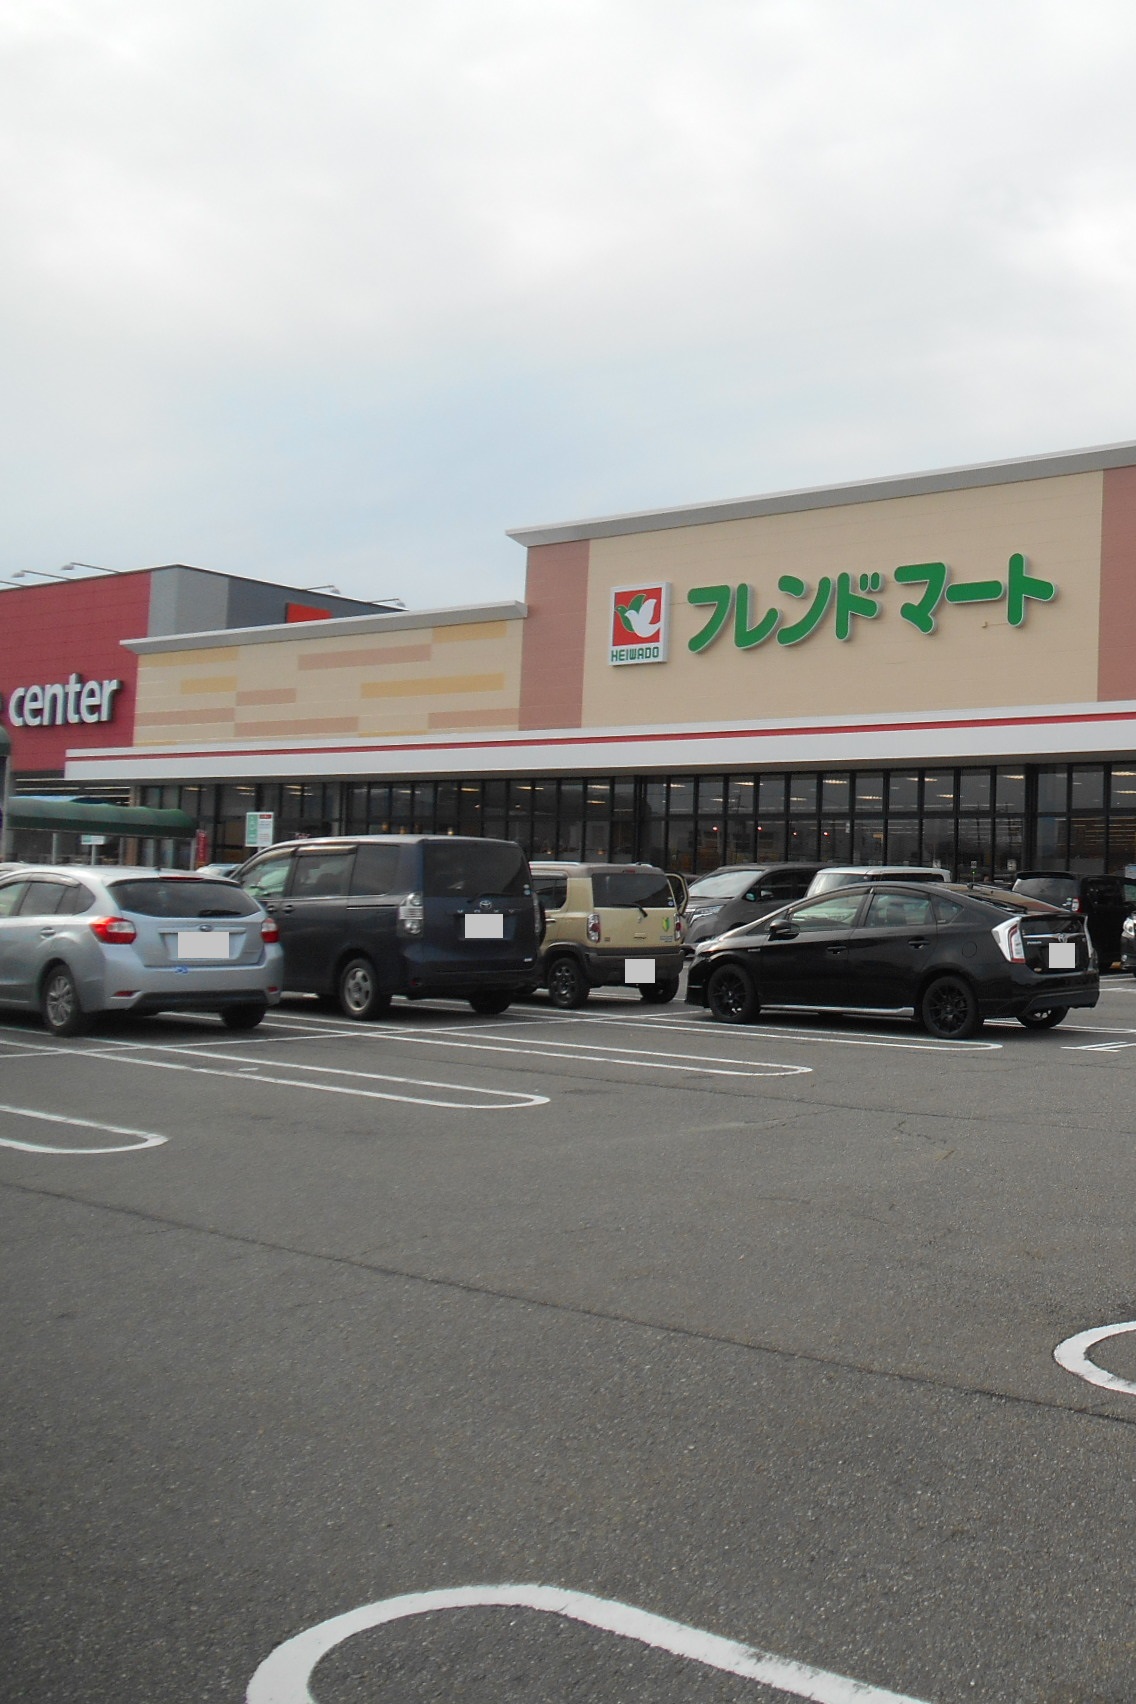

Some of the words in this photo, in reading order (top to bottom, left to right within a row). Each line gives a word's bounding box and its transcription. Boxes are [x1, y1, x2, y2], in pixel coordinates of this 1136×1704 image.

[686, 551, 1058, 654] フレンドマート
[611, 646, 660, 662] HEIWADO
[8, 672, 121, 727] center
